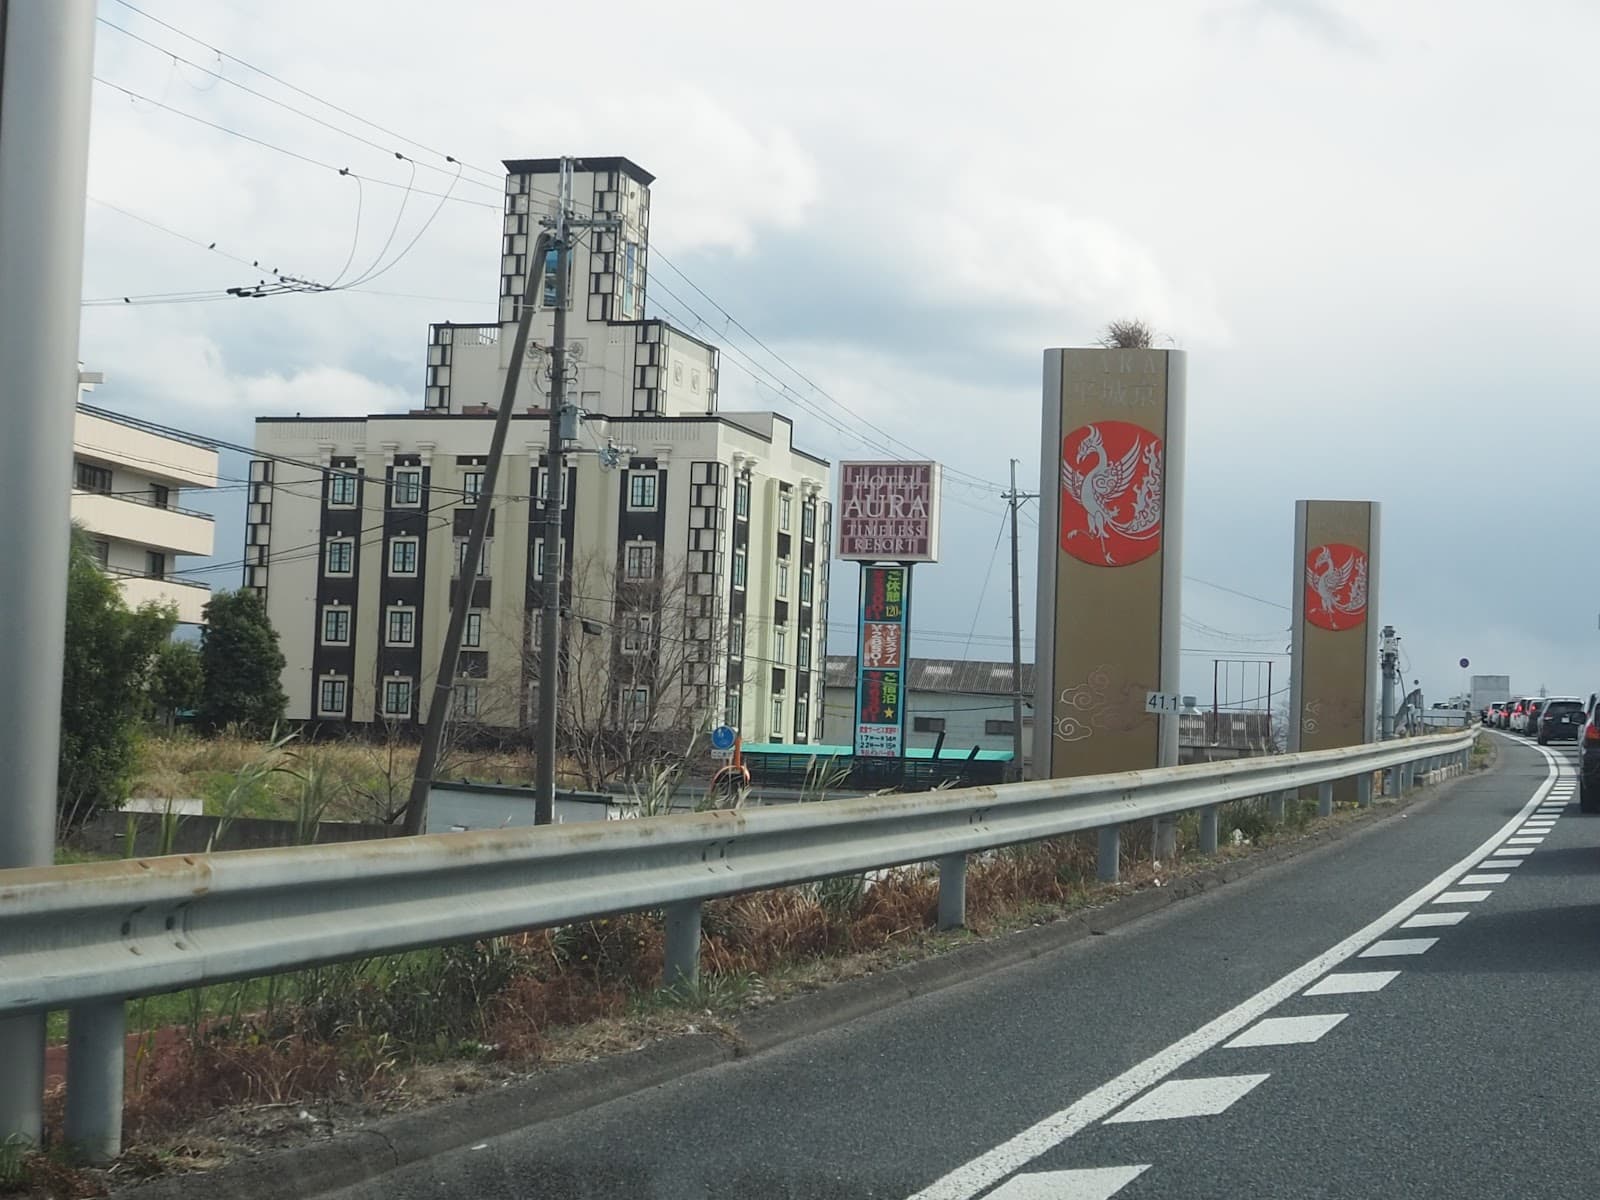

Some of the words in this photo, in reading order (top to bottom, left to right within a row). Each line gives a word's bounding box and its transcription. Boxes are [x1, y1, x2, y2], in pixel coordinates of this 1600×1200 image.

[855, 475, 919, 489] HOTEL
[843, 495, 928, 518] AURA
[847, 524, 922, 537] TIMELESS
[854, 538, 916, 551] RESORT
[1148, 694, 1177, 711] 41.1
